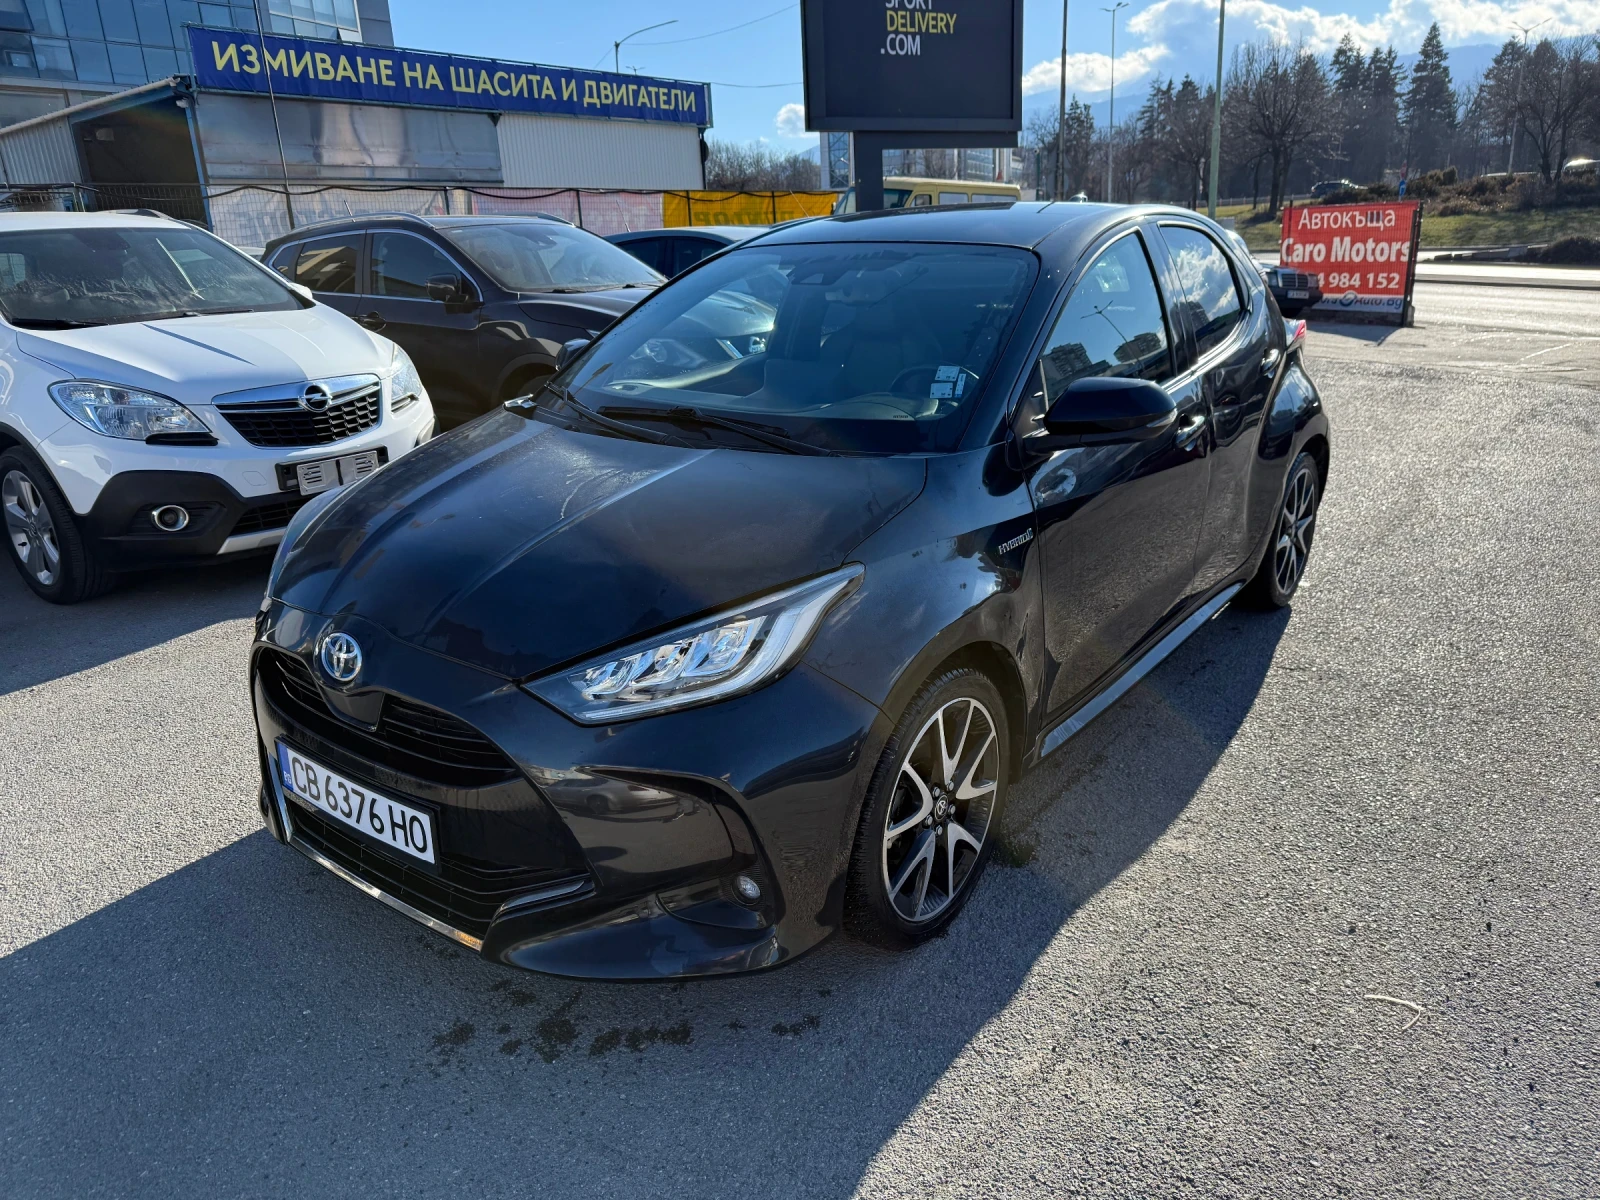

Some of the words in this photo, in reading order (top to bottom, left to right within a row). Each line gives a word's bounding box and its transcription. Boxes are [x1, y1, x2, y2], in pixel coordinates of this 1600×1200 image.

[886, 10, 957, 34] DELIVERY
[880, 33, 920, 56] .COM
[211, 40, 396, 87] ИЗМИВАНЕ
[402, 61, 444, 91] НА
[449, 65, 557, 100] ШАСИТА
[561, 77, 578, 102] И
[583, 80, 696, 113] ДВИГАТЕЛИ
[1297, 208, 1396, 231] Автокъща
[1281, 237, 1327, 263] Caro
[1330, 236, 1411, 263] Motors
[1328, 272, 1361, 288] 984
[1366, 272, 1400, 289] 152
[324, 775, 385, 835] 6376
